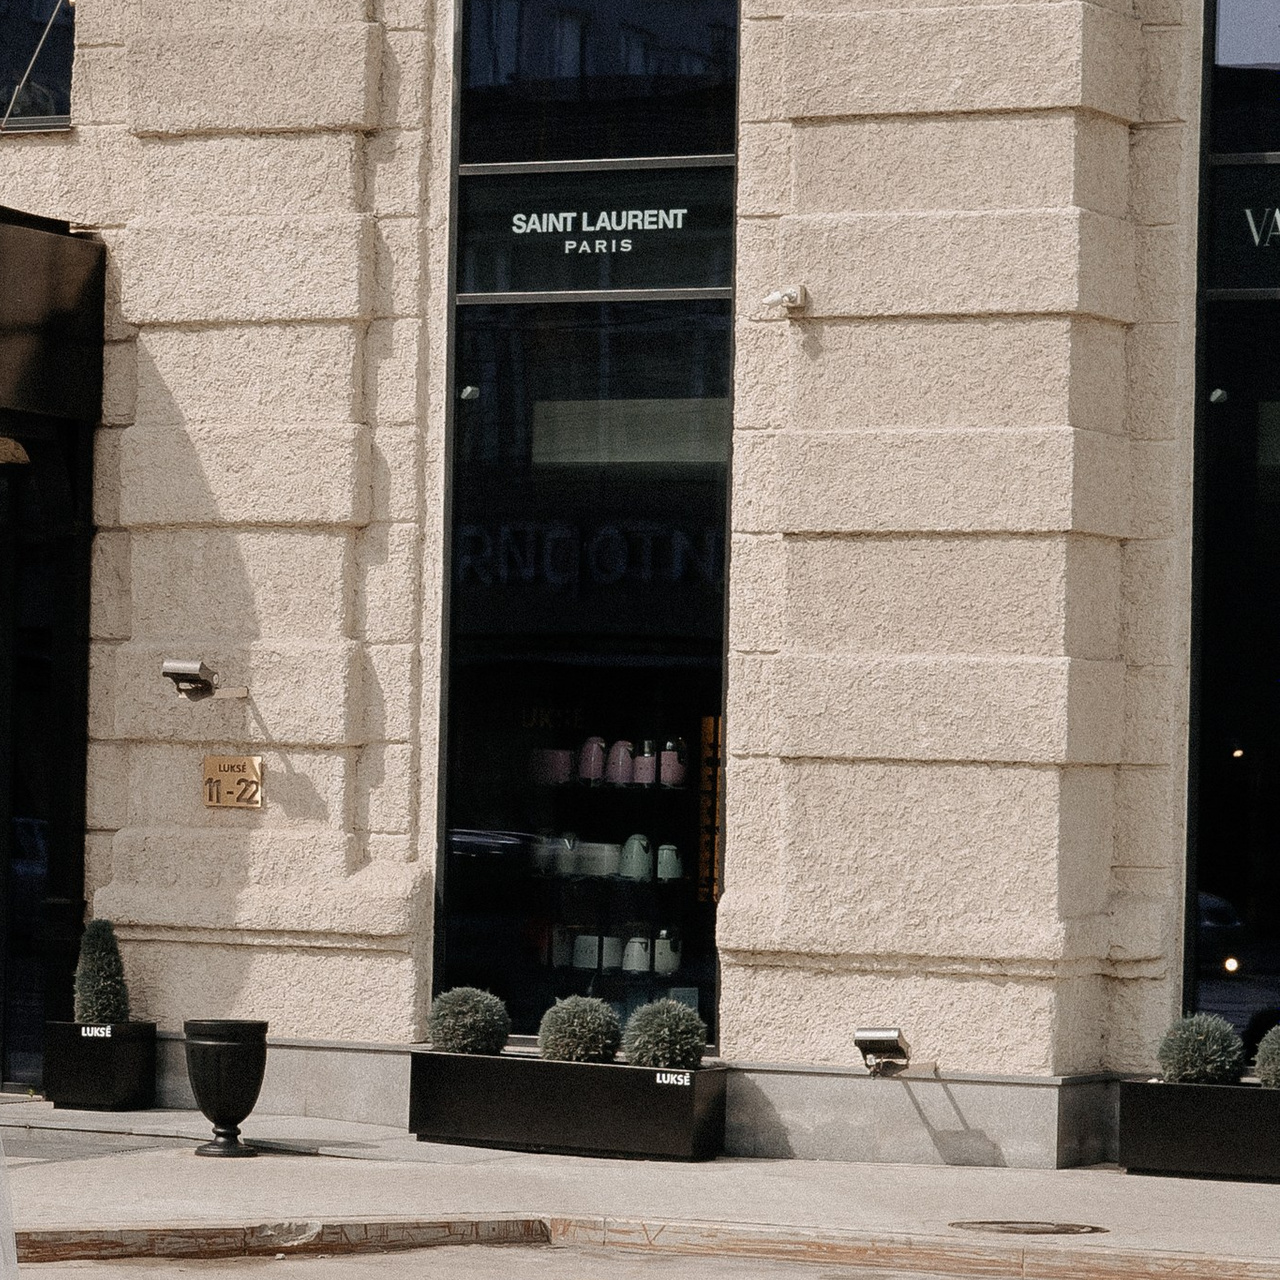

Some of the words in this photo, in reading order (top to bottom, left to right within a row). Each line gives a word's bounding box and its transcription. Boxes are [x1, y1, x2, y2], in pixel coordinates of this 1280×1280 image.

[511, 212, 578, 234] SAINT
[581, 209, 688, 232] LAURENT
[564, 239, 633, 254] PARIS
[218, 762, 247, 773] LUKSÉ
[81, 1025, 112, 1038] LUKSÉ
[655, 1072, 691, 1086] LUKSÉ
